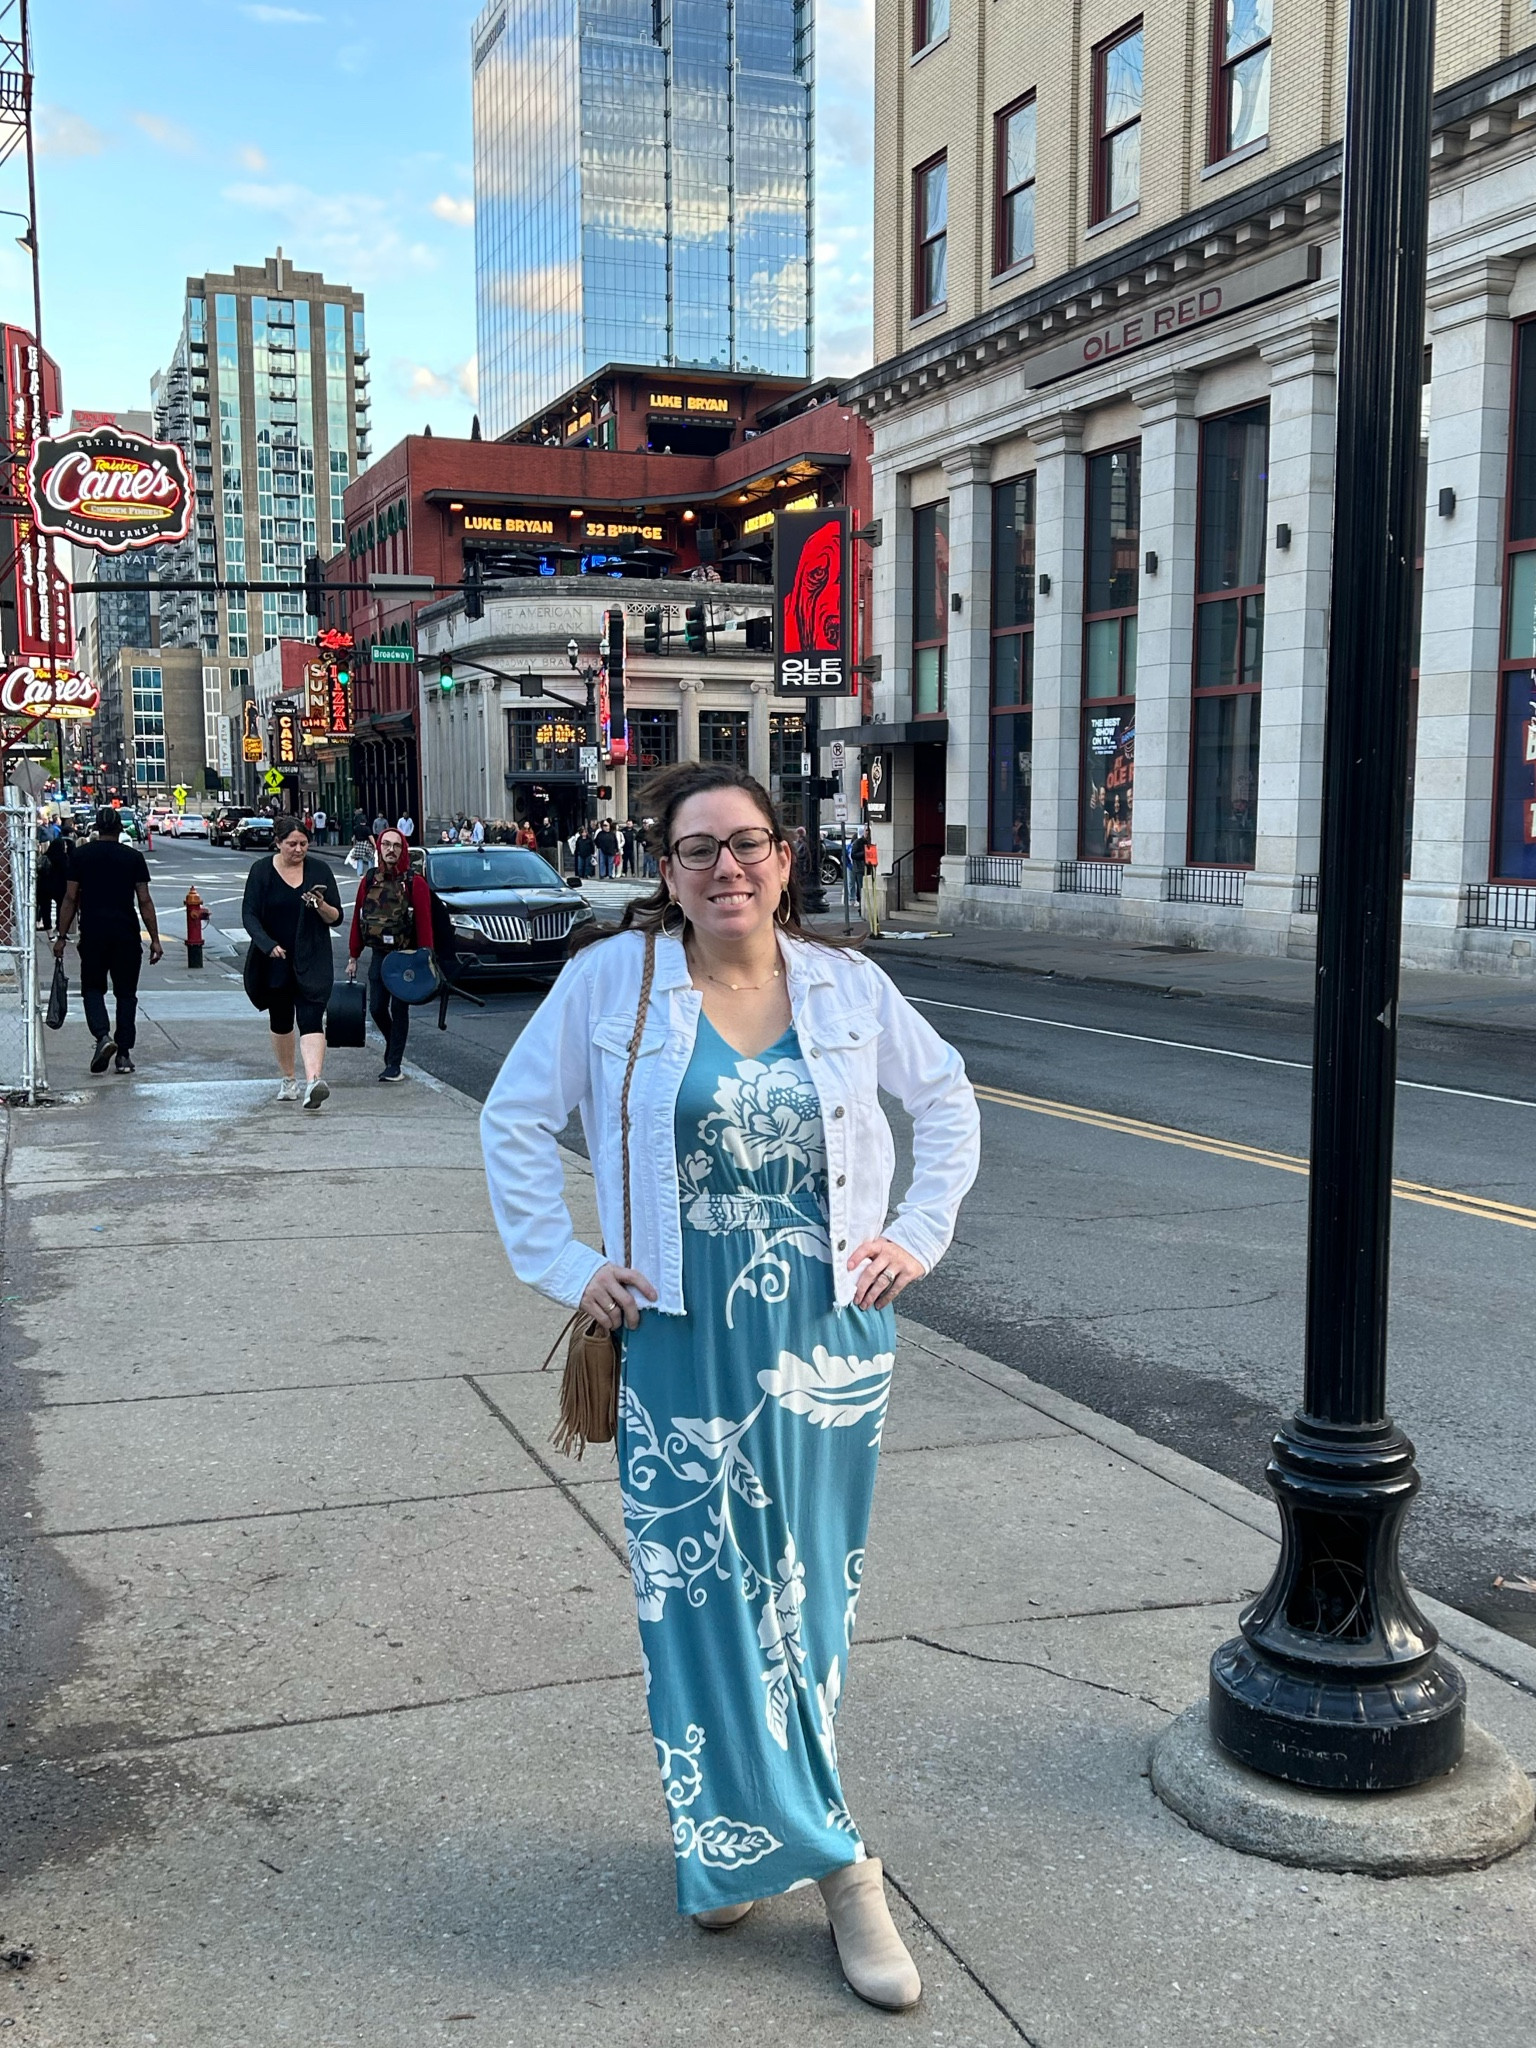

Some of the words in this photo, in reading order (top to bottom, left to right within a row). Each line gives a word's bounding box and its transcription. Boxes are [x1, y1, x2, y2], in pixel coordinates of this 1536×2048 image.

[1083, 317, 1143, 361] OLE
[1154, 286, 1222, 335] RED
[650, 393, 682, 409] LUKE
[687, 396, 728, 412] BRYAN
[78, 438, 104, 449] EST.
[95, 459, 139, 475] Raising
[45, 451, 178, 511] Cane's
[66, 519, 114, 538] RAISING
[119, 523, 159, 538] CANE'S
[464, 516, 502, 531] LUKE
[505, 518, 554, 534] BRYAN
[586, 522, 606, 537] 32
[114, 555, 158, 565] HYATT
[495, 608, 513, 619] THE
[519, 606, 582, 619] AMERICAN
[549, 621, 584, 633] BANK
[374, 649, 410, 661] Broadway
[542, 656, 590, 667] BRANH
[781, 657, 843, 673] OLE
[35, 668, 69, 680] Raing
[781, 671, 843, 686] RED
[310, 663, 324, 707] SUN
[1091, 718, 1103, 728] THE
[1104, 717, 1121, 727] BEST
[279, 716, 294, 762] CASH
[1095, 727, 1115, 737] SHOW
[1092, 736, 1102, 745] ON
[1106, 766, 1127, 789] OLE
